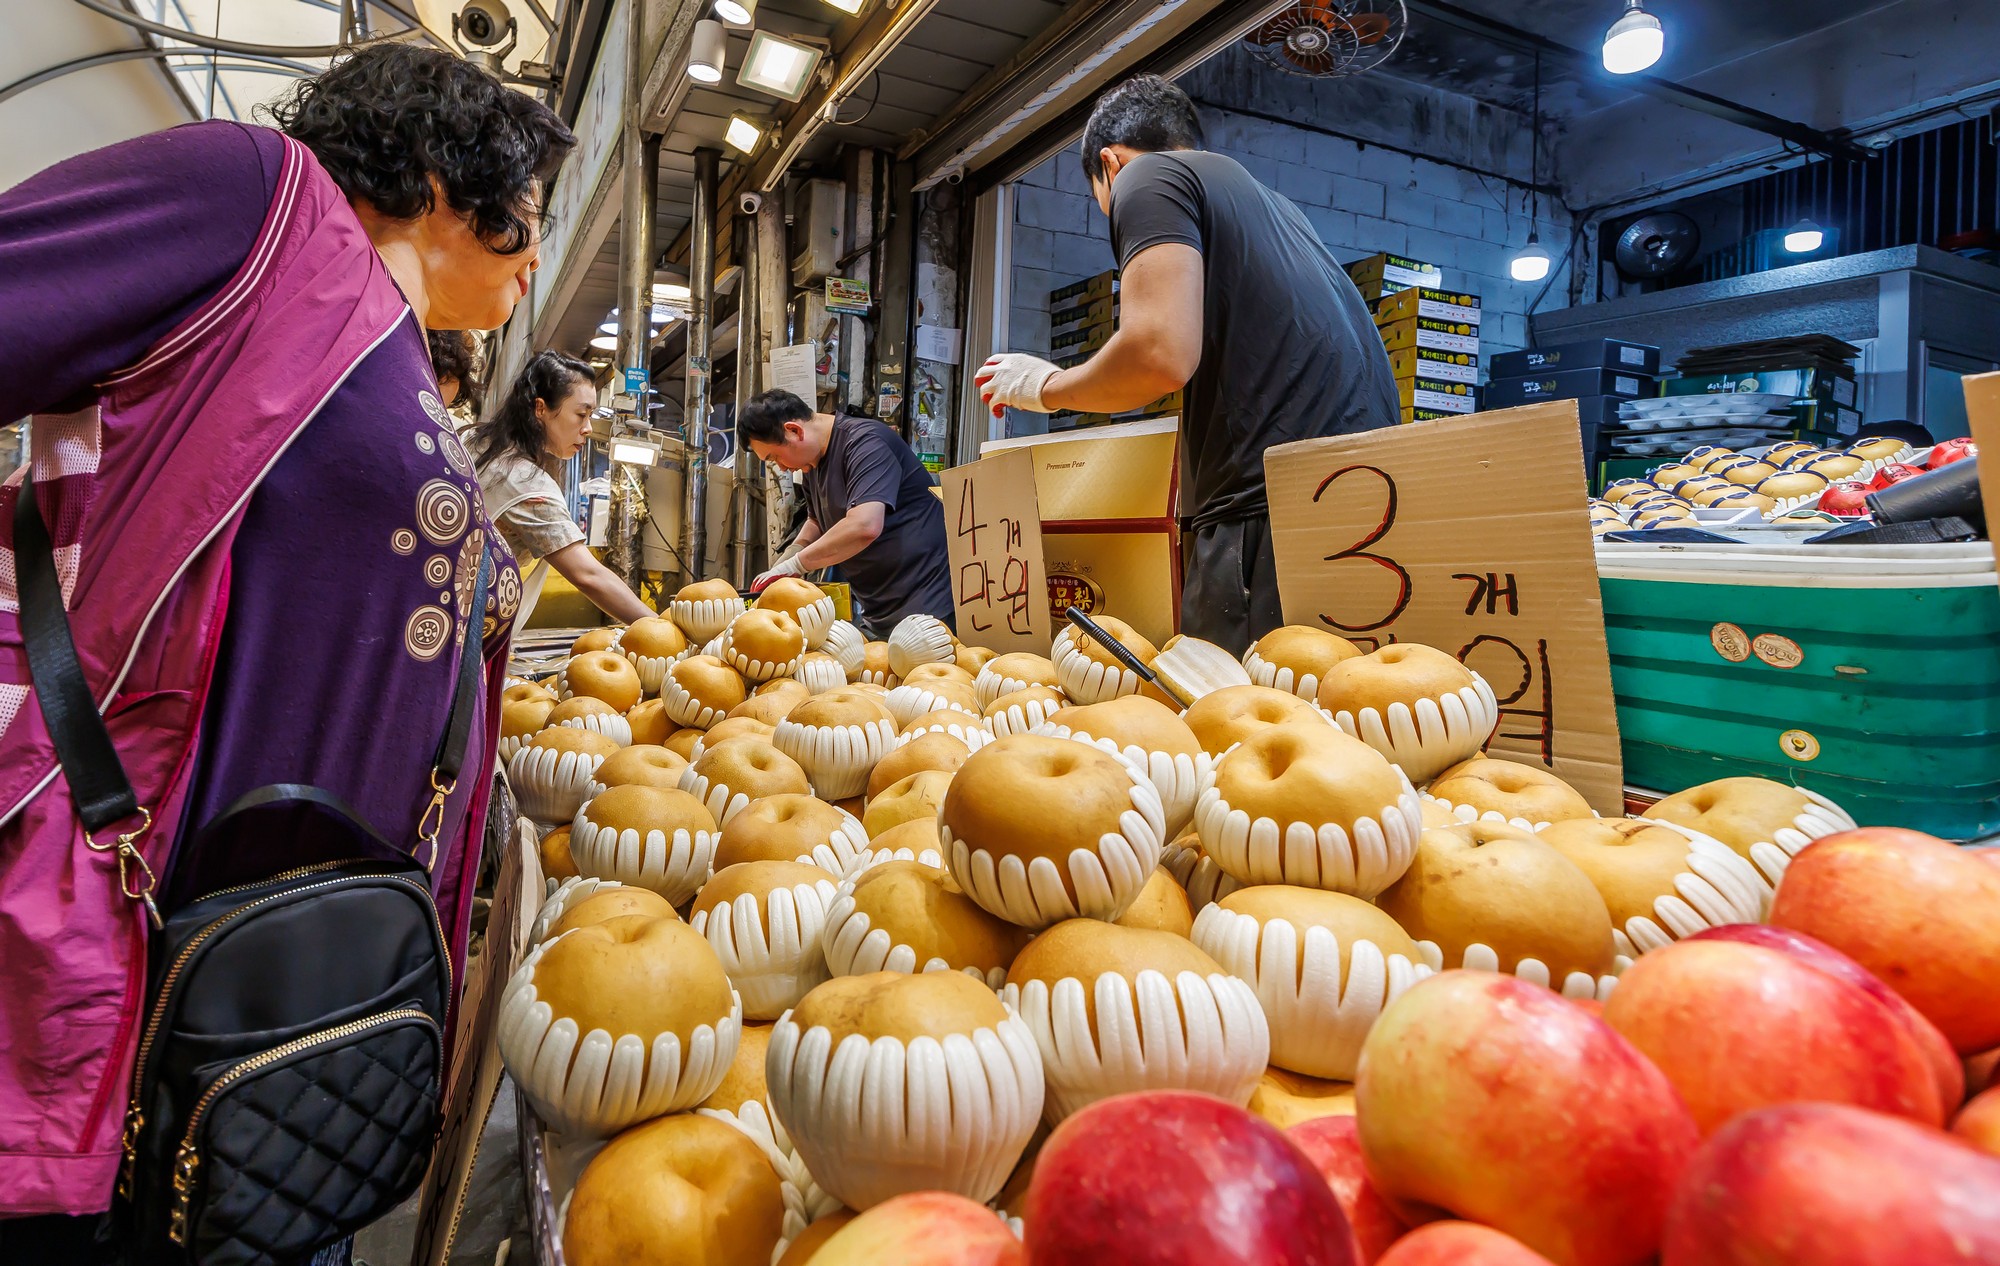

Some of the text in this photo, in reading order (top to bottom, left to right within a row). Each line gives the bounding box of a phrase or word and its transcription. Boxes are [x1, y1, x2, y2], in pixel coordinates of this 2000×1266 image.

[1046, 460, 1085, 471] Premium Pear
[1047, 586, 1092, 611] 品梨
[1757, 641, 1798, 662] INCARIA
